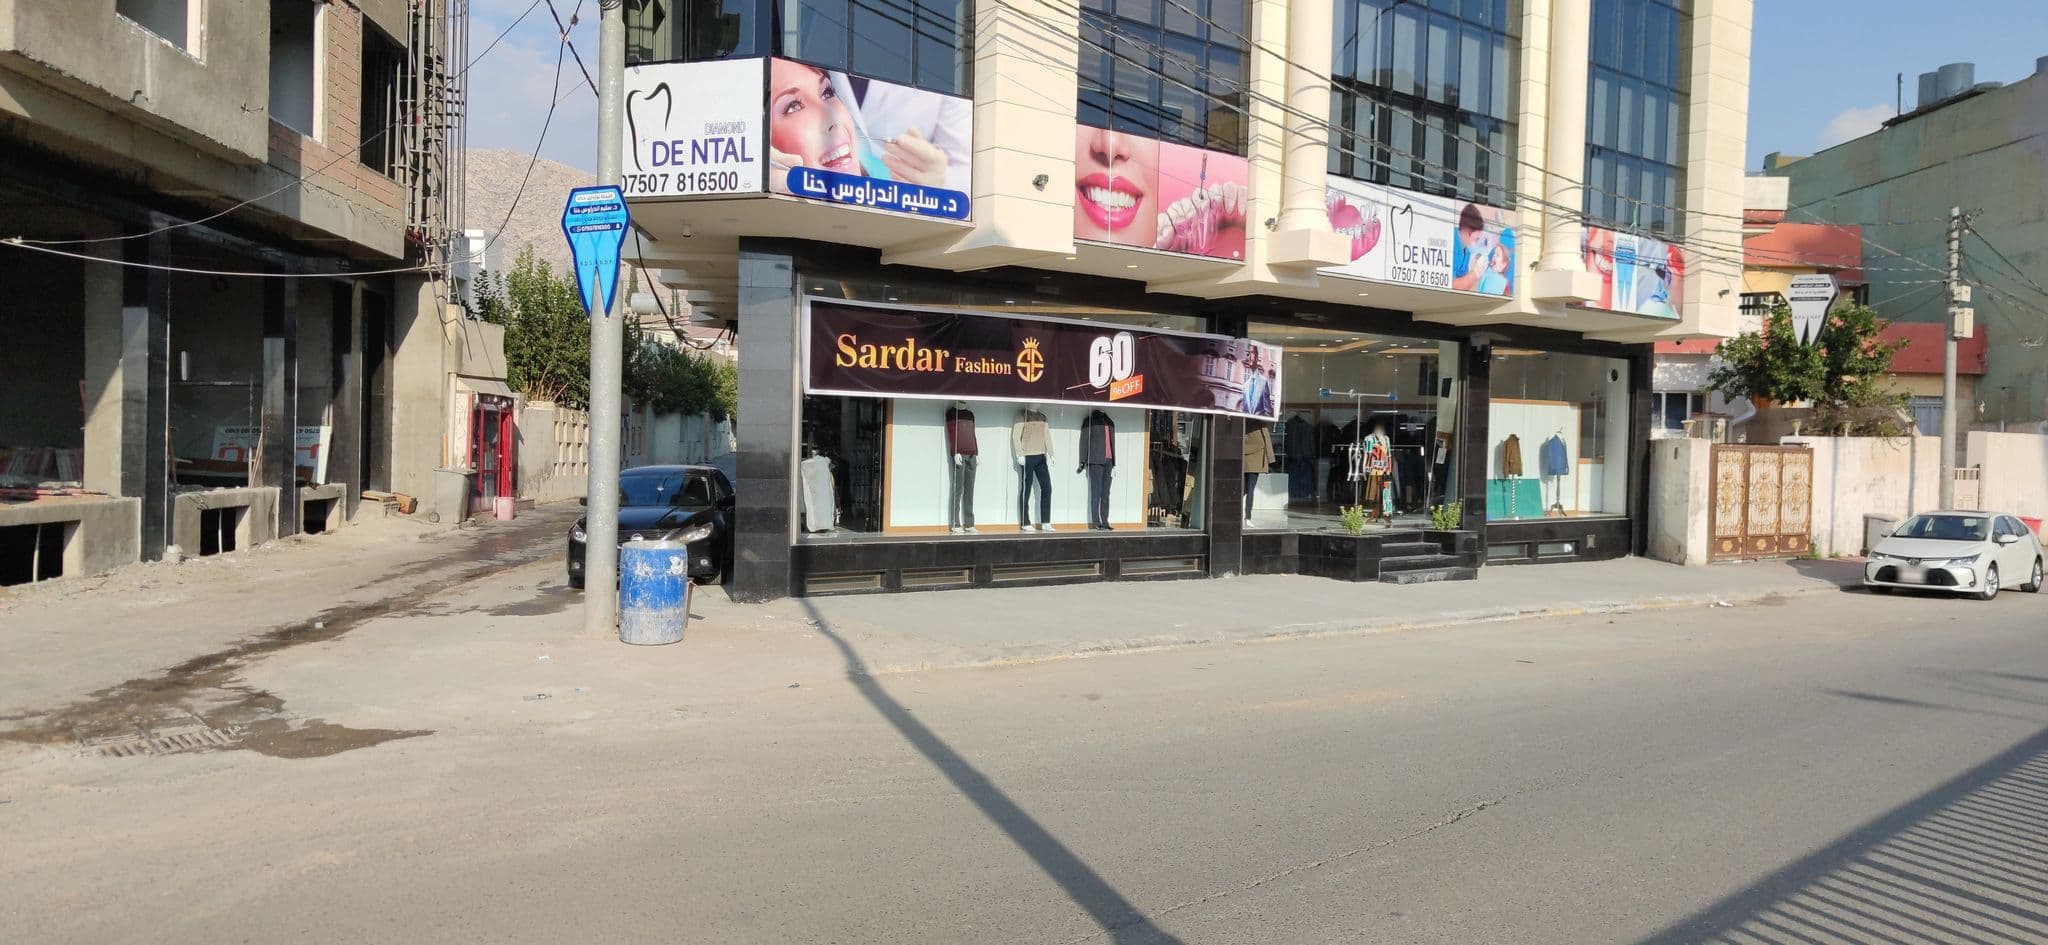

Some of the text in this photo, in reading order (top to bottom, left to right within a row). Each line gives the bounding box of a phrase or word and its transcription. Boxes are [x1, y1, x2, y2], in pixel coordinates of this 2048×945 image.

[704, 121, 746, 135] DIAMOND
[676, 171, 739, 192] 816500
[803, 171, 957, 212] د. سليم اندراوس حنا
[1392, 266, 1448, 286] 07507 816500
[836, 333, 950, 372] Sardar
[954, 356, 1012, 375] Fashion
[1089, 331, 1135, 389] 60
